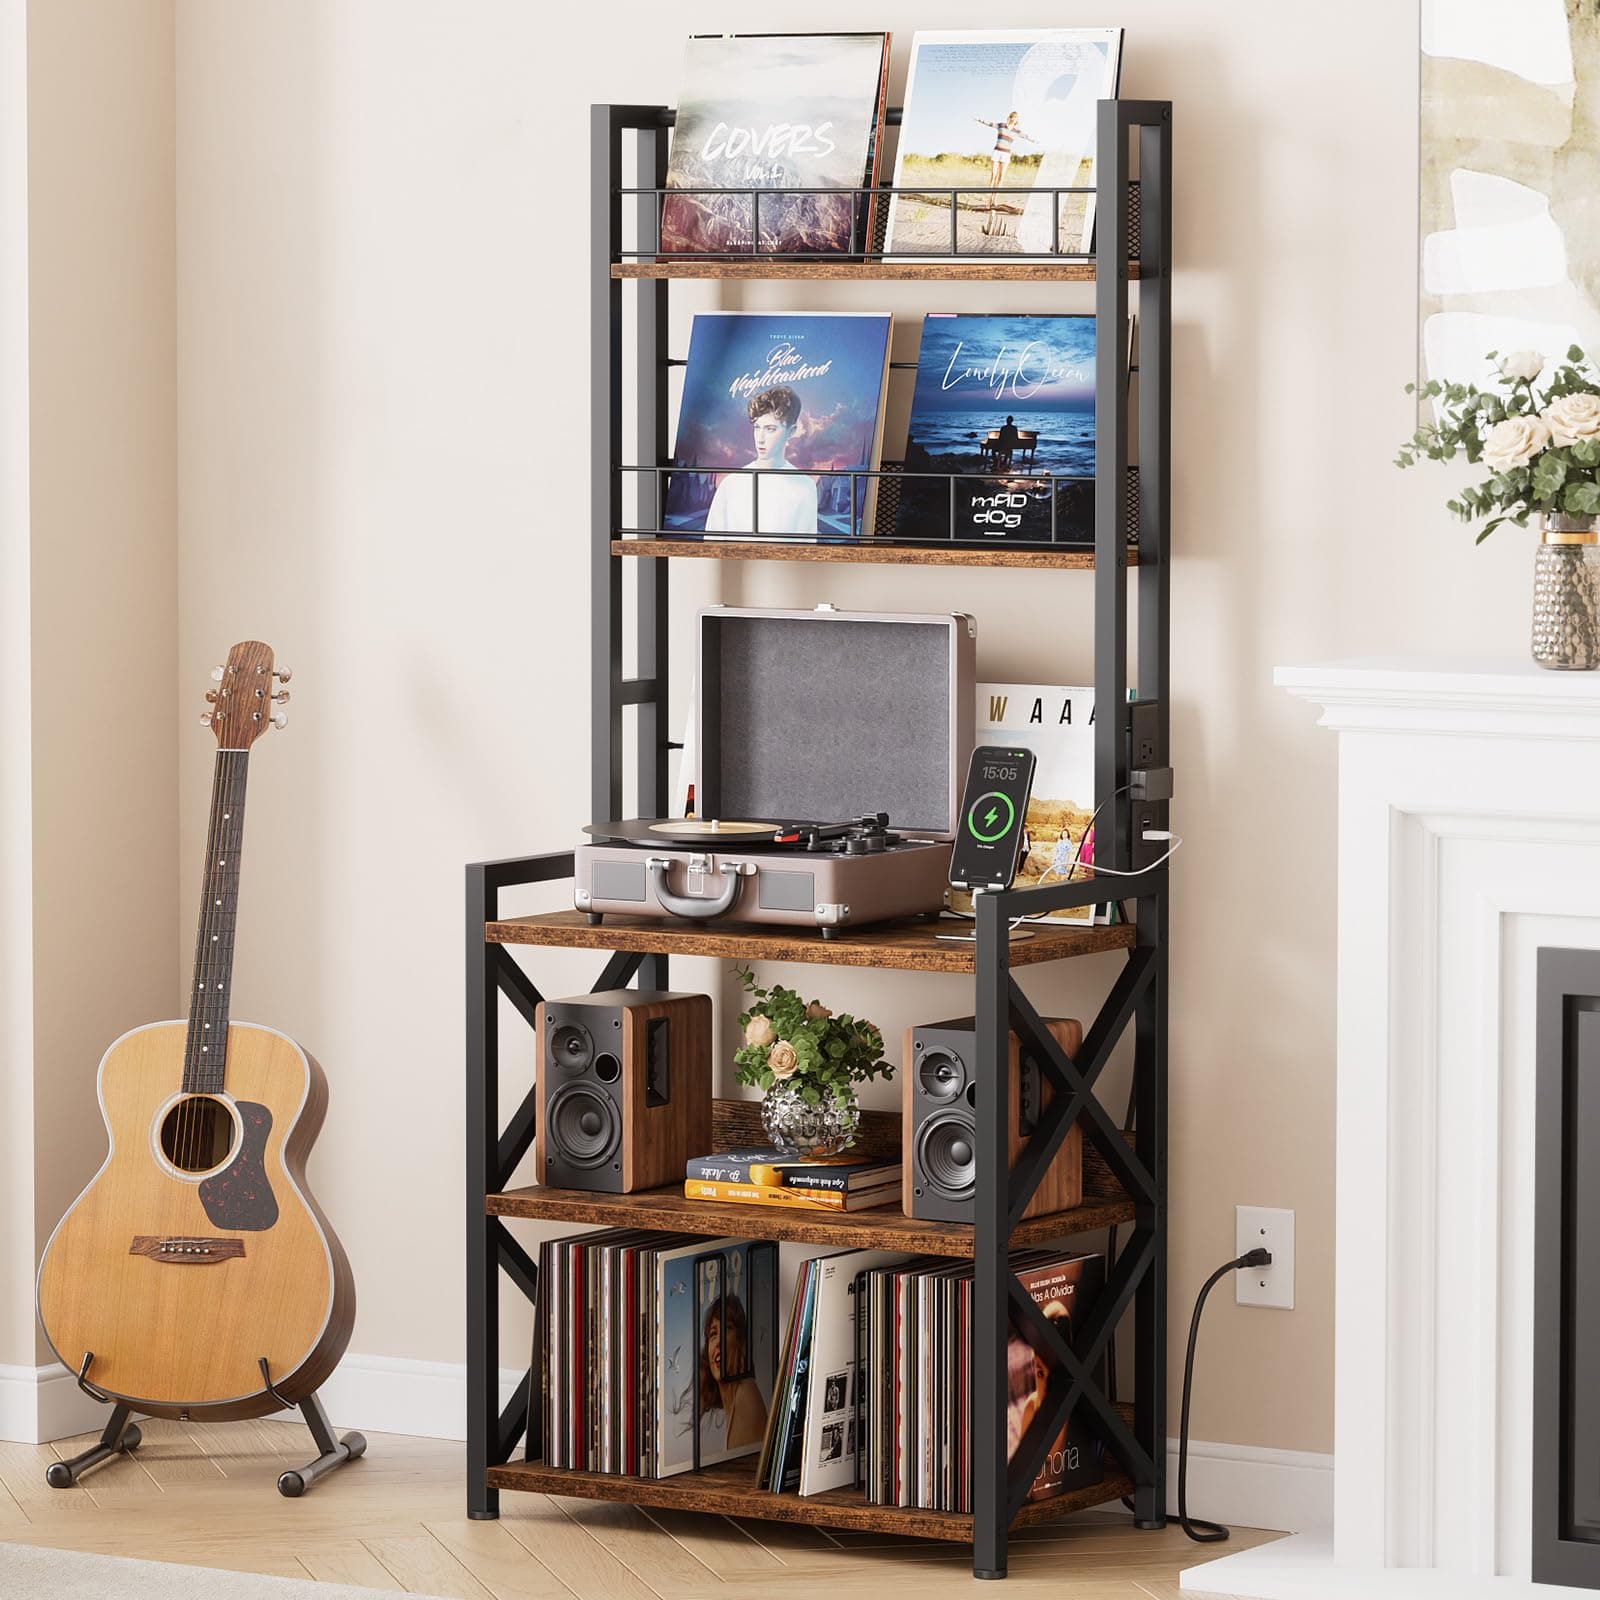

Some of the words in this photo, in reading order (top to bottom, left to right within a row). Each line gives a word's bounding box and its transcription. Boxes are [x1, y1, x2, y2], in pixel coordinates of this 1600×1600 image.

[700, 121, 836, 161] COVERS
[766, 342, 803, 367] Blue
[942, 341, 1014, 400] Lonely
[1012, 341, 1089, 400] Ocean
[982, 766, 1018, 781] 15:05
[1044, 1289, 1050, 1300] A
[1050, 1284, 1075, 1299] Olvidar
